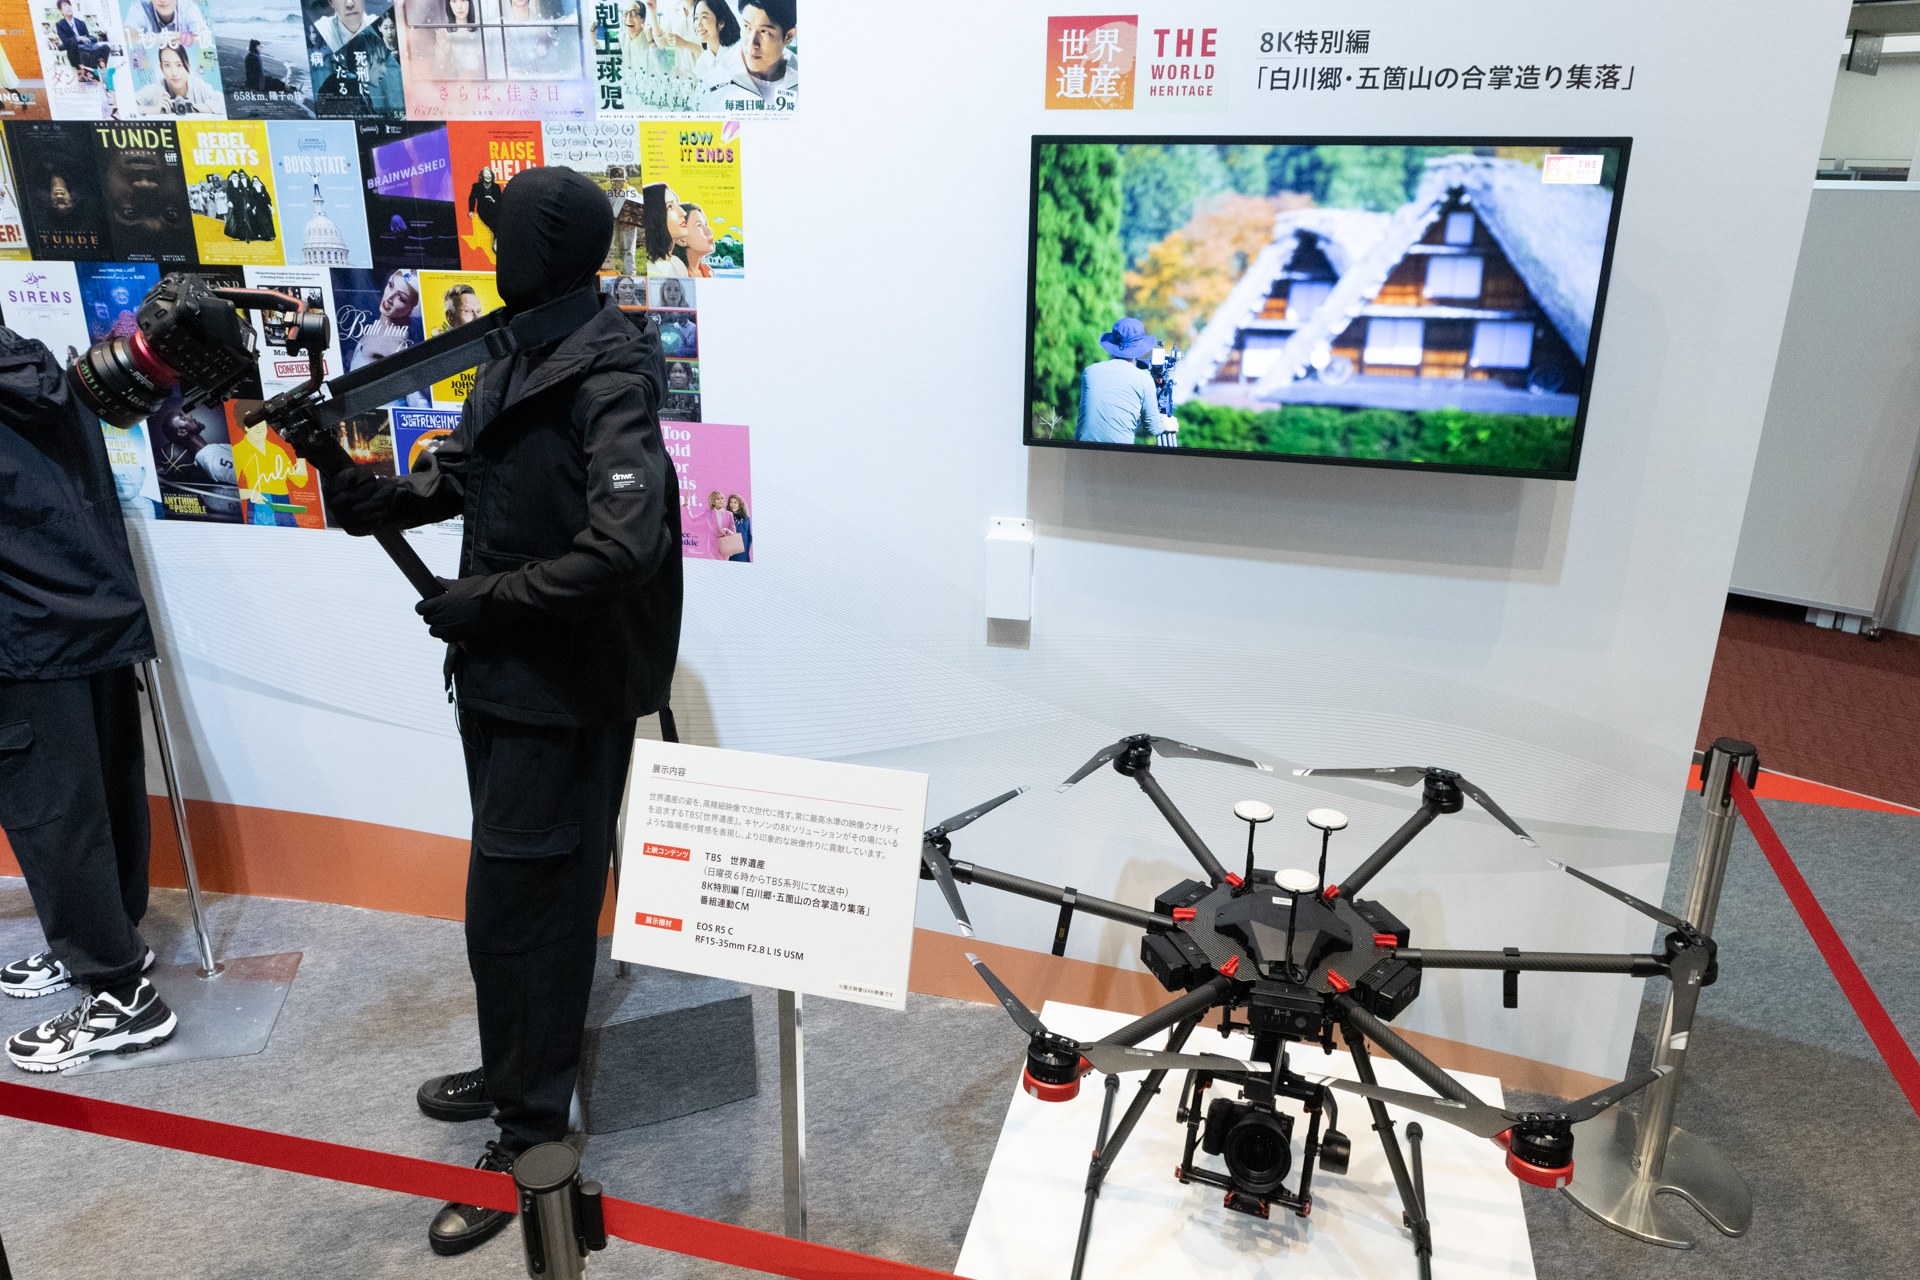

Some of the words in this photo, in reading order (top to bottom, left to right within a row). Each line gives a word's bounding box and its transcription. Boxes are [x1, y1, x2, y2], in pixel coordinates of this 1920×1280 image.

[1058, 28, 1123, 63] 世界
[1153, 28, 1217, 58] THE
[1260, 30, 1370, 55] 8K特別編
[310, 52, 324, 67] 病
[595, 0, 625, 110] 剋上球児
[353, 51, 370, 95] 死刑に
[1151, 64, 1215, 80] WORLD
[1257, 64, 1635, 91] 「白川郷・五箇山の合掌造り集落」
[1055, 64, 1121, 99] 遺産
[1150, 85, 1213, 96] HERITAGE
[96, 128, 174, 149] TUNDE
[197, 132, 250, 149] REBEL
[679, 131, 713, 146] HOW
[193, 149, 259, 166] HEARTS
[489, 141, 536, 160] RAISE
[680, 147, 693, 162] IT
[696, 148, 734, 163] ENDS
[283, 155, 312, 174] BOYS
[313, 155, 349, 174] STATE
[1579, 160, 1598, 168] THE
[367, 158, 446, 189] BRAINWASHED
[604, 187, 637, 198] ators
[40, 235, 99, 245] TUNDE
[8, 290, 72, 303] SIRENS
[412, 414, 462, 429] FRENCHME
[661, 425, 691, 441] Too
[666, 442, 692, 458] old
[109, 452, 138, 465] LACE
[674, 462, 690, 474] or
[244, 453, 308, 503] Julia
[679, 475, 697, 491] is
[164, 496, 199, 506] ANYTHING
[174, 504, 207, 514] POSSIBLE
[651, 763, 687, 777] 展示内容
[644, 845, 689, 858] 上映コンテンツ
[705, 852, 722, 863] TBS
[730, 855, 766, 870] 世界遺産
[700, 895, 750, 911] 番組連動CM
[645, 916, 673, 928] 展示機材
[696, 922, 713, 932] EOS
[715, 925, 726, 934] R5
[728, 927, 734, 936] C
[695, 934, 746, 951] RF15-35mm
[747, 943, 765, 955] F2.8
[767, 946, 772, 955] L
[773, 948, 782, 957] IS
[783, 950, 804, 960] USM
